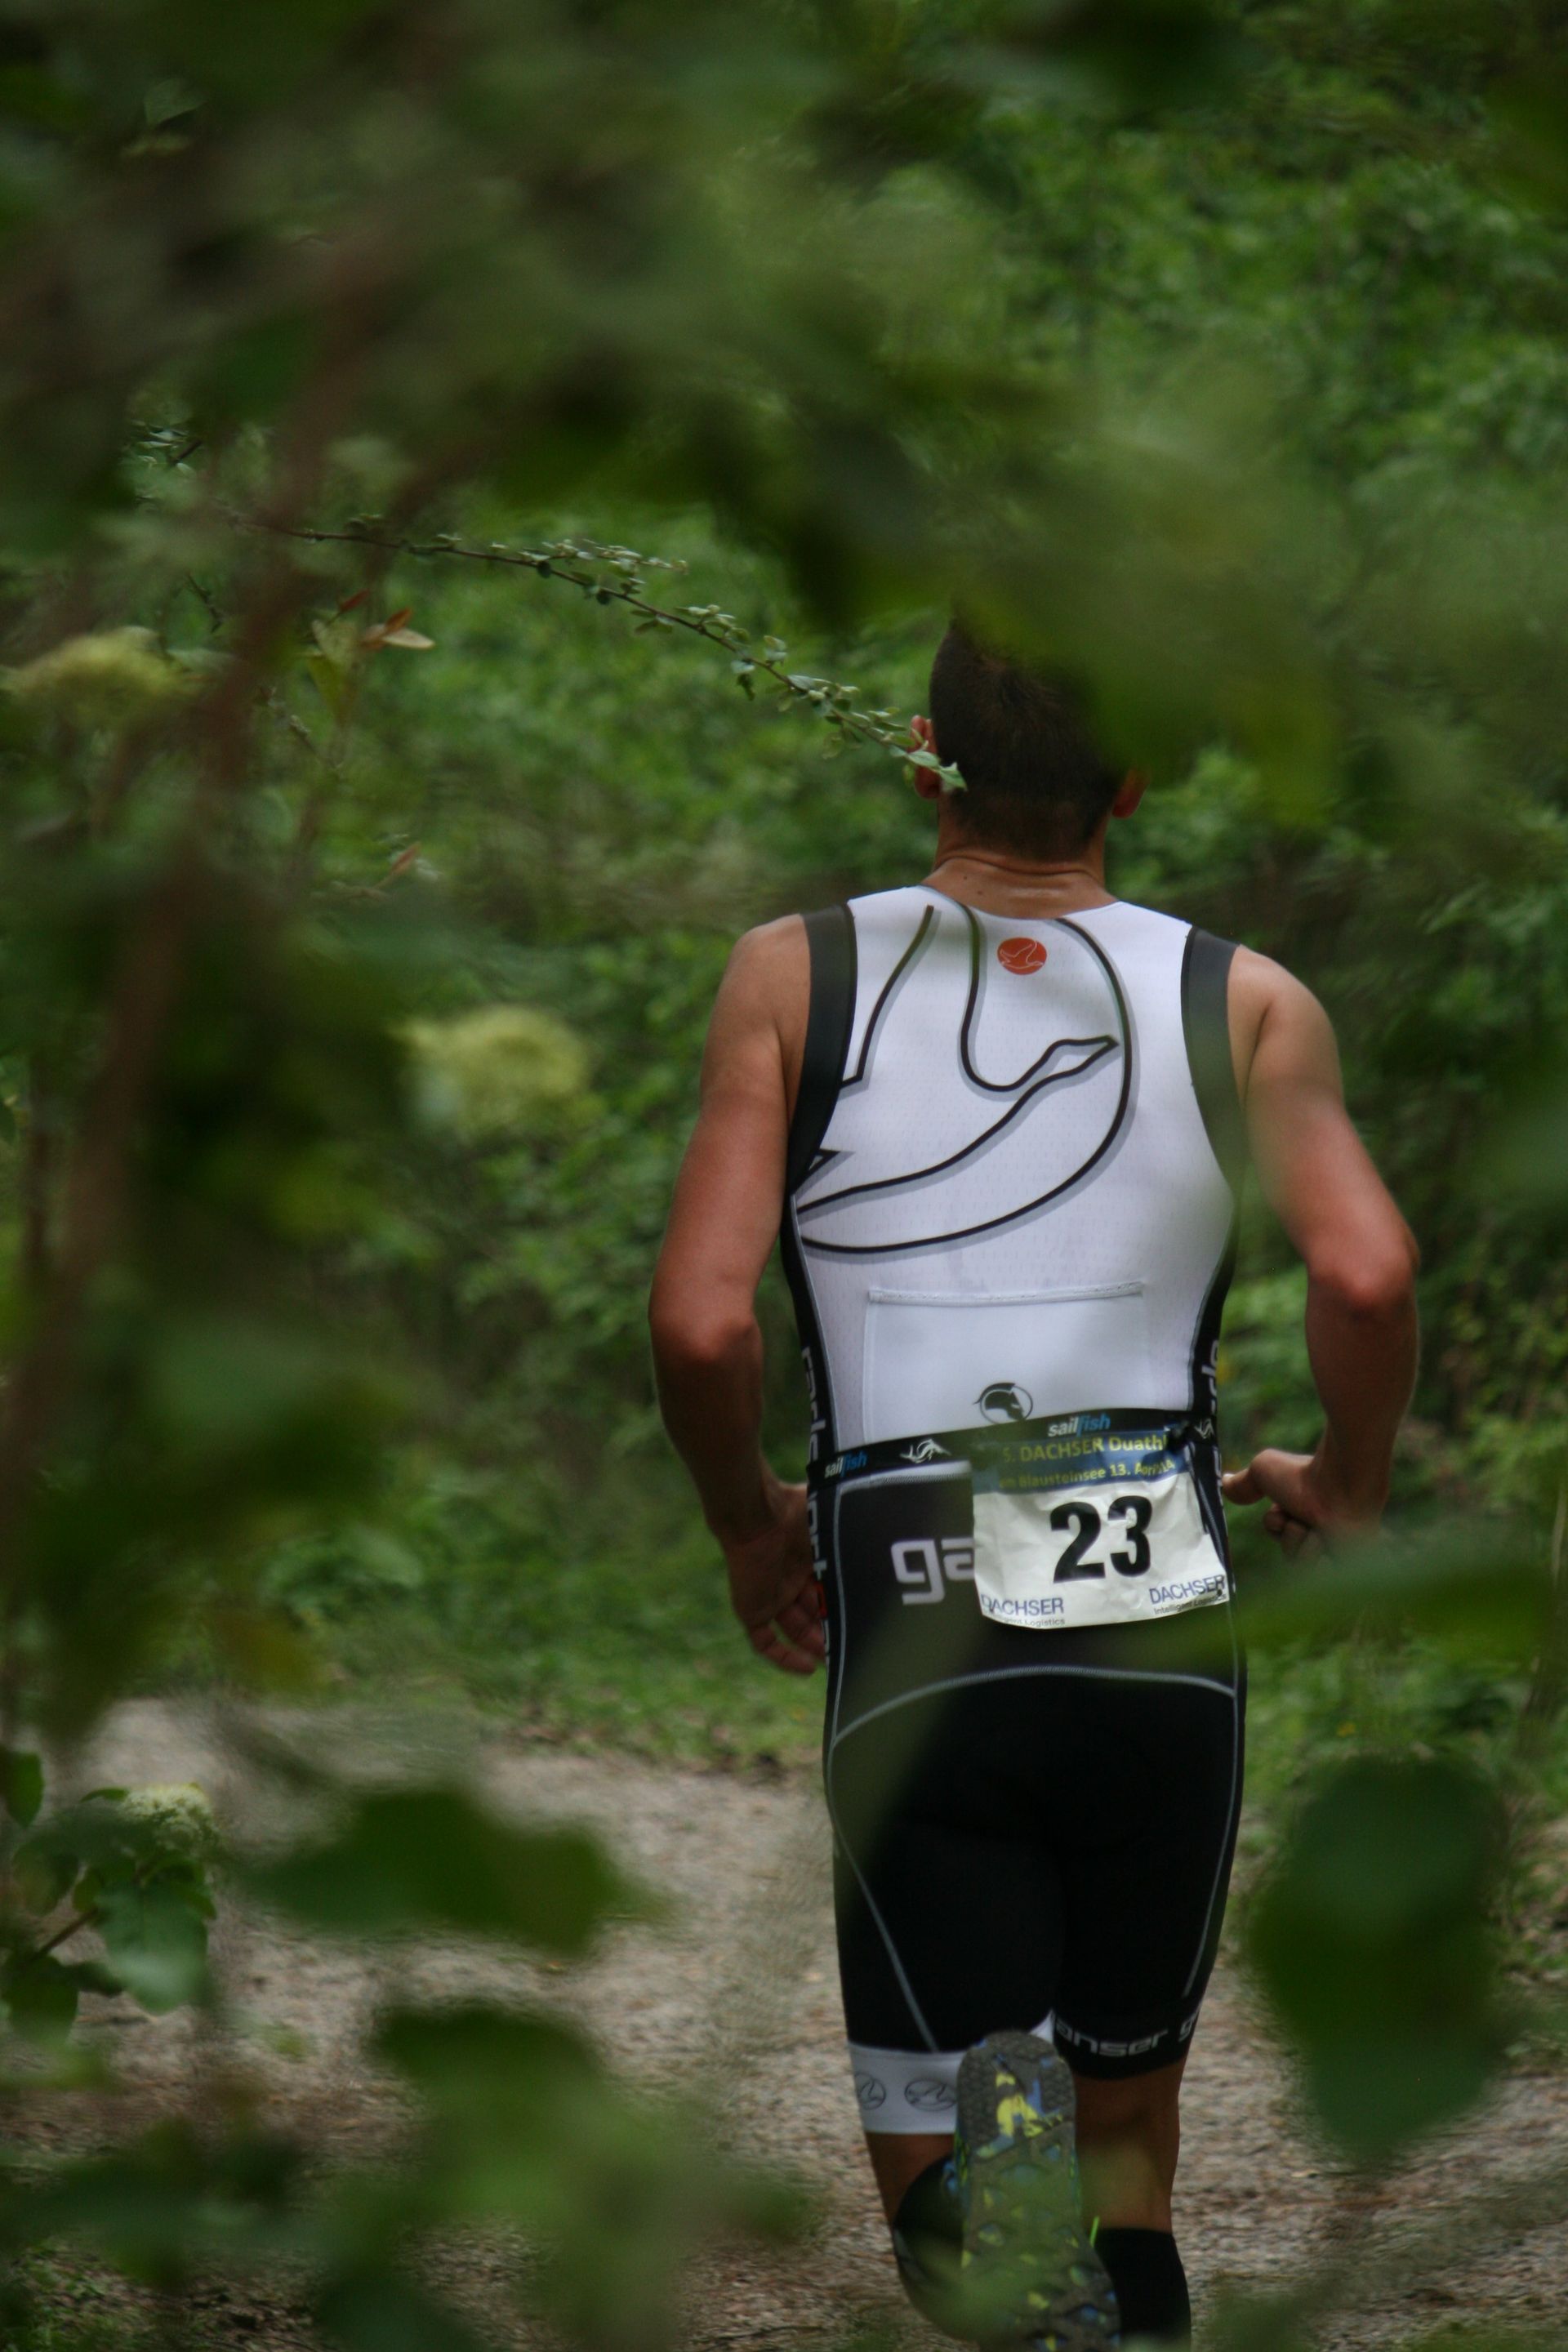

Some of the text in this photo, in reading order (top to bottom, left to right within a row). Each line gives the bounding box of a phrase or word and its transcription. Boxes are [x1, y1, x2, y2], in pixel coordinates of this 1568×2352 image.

[1048, 1414, 1111, 1437] sailfish
[1020, 1437, 1104, 1462] DACHSER
[825, 1450, 867, 1479] sailfish
[1110, 1463, 1131, 1477] 13.
[1049, 1495, 1152, 1584] 23
[1148, 1575, 1225, 1604] DACHSER
[981, 1593, 1064, 1616] DACHSER
